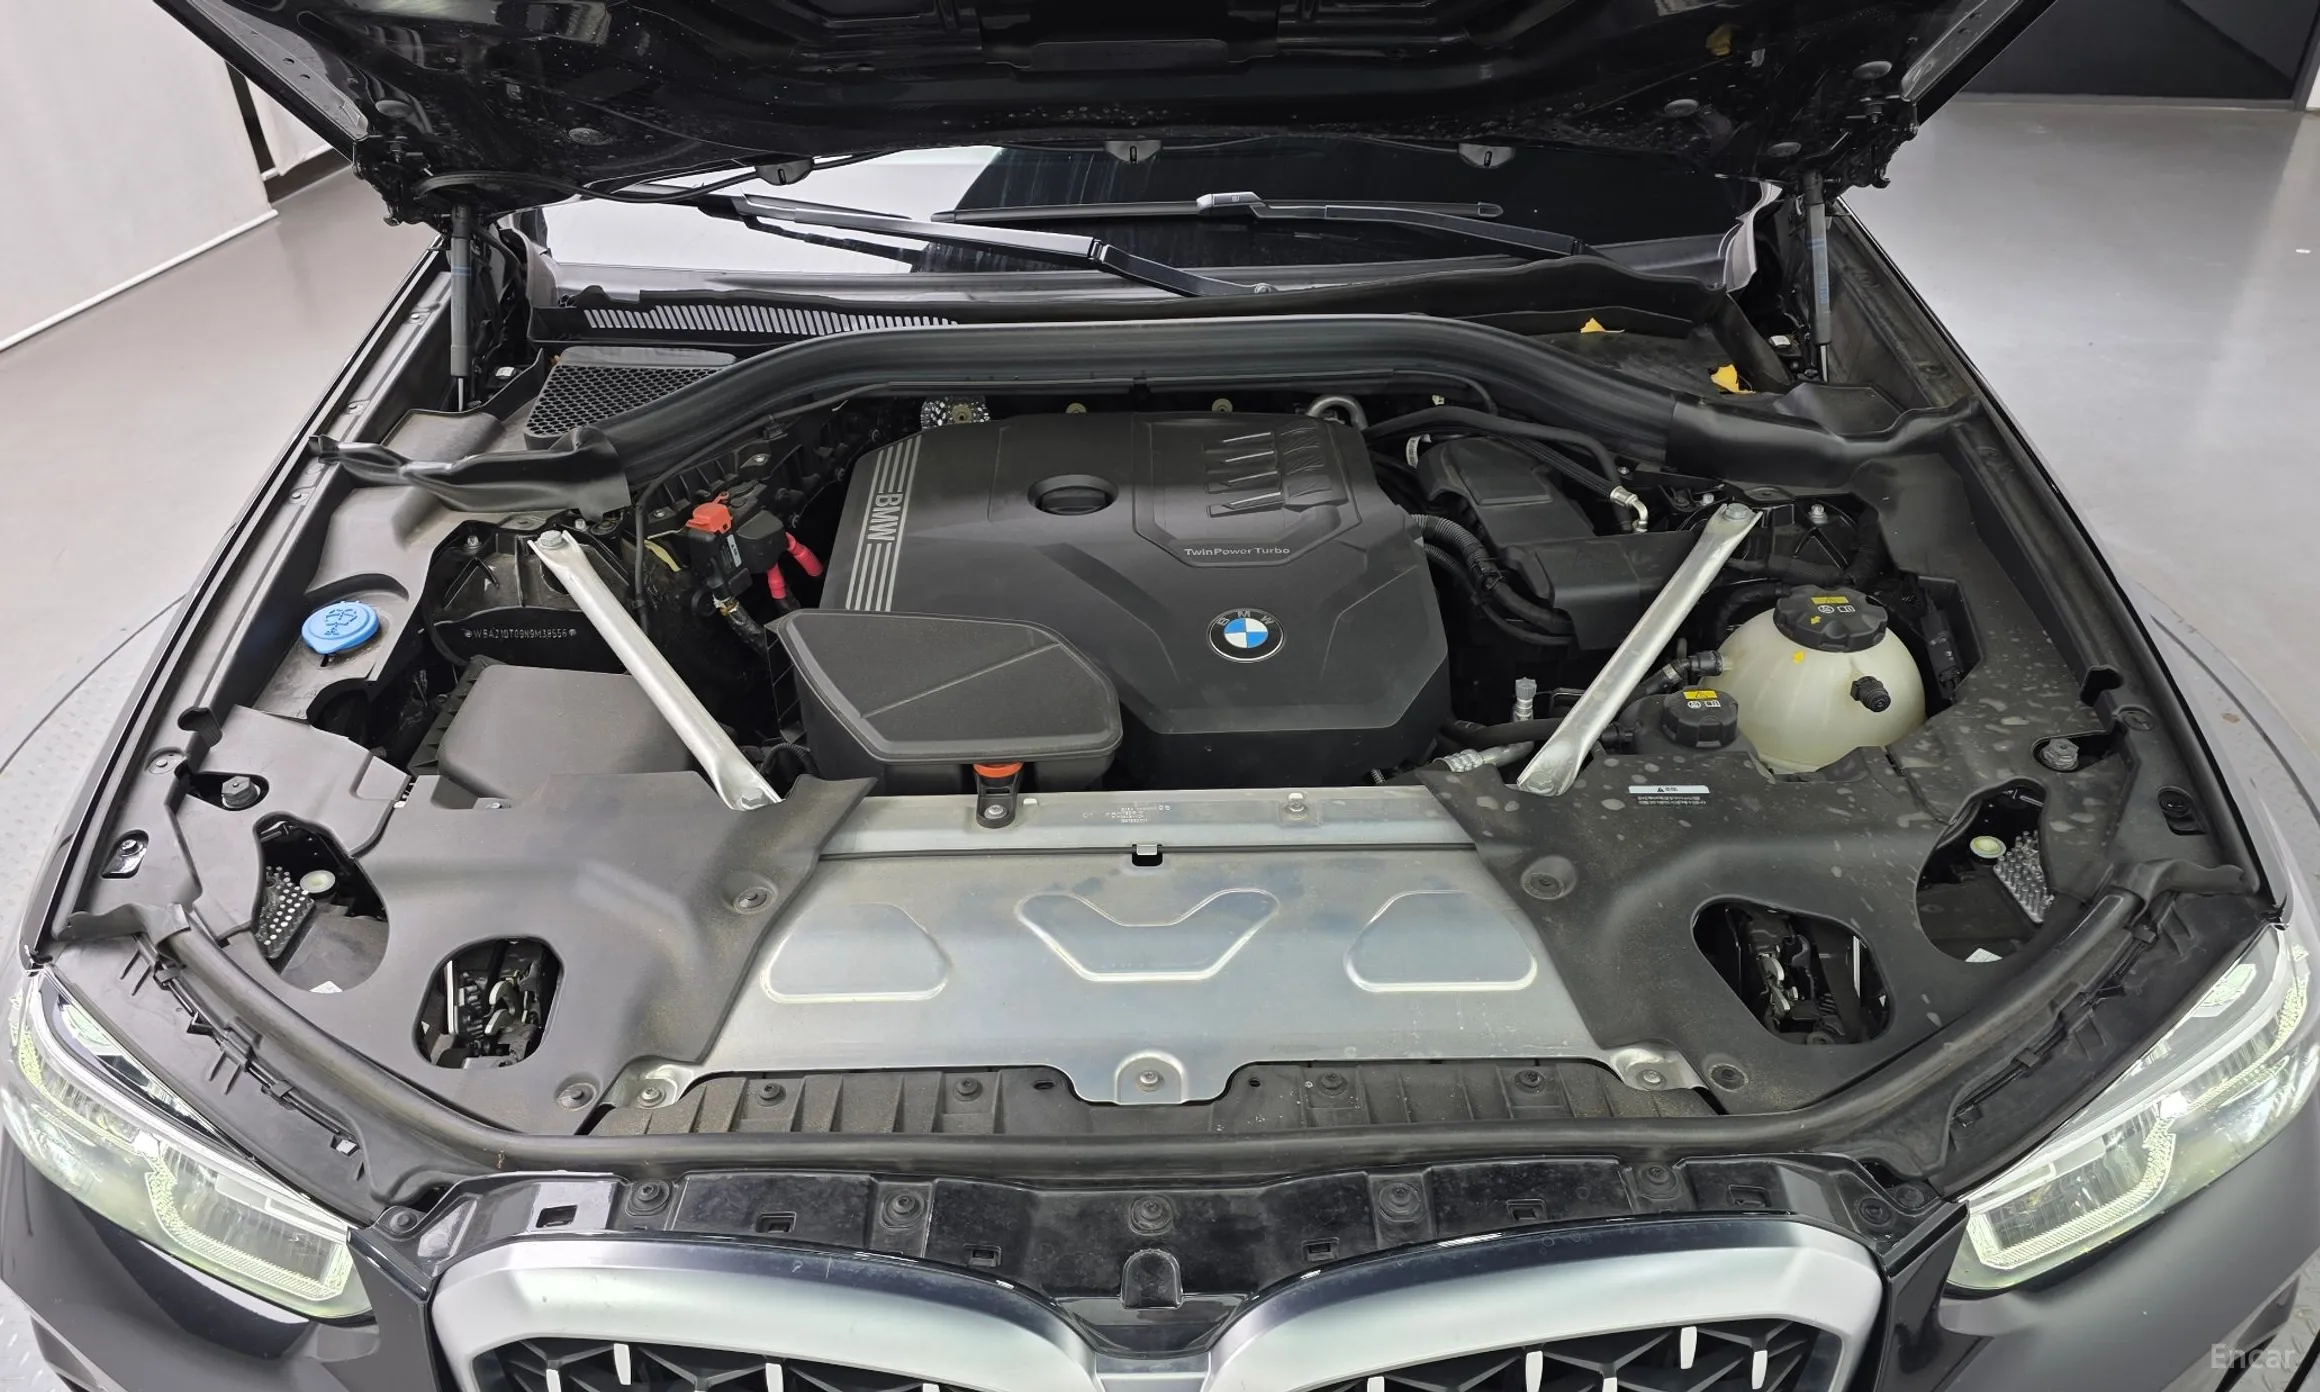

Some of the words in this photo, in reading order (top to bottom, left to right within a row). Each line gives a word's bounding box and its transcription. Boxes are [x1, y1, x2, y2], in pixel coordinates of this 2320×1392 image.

[867, 493, 904, 541] BMW
[1183, 547, 1253, 556] TwinPower
[1254, 547, 1291, 555] Turbo
[1216, 609, 1275, 627] BMW
